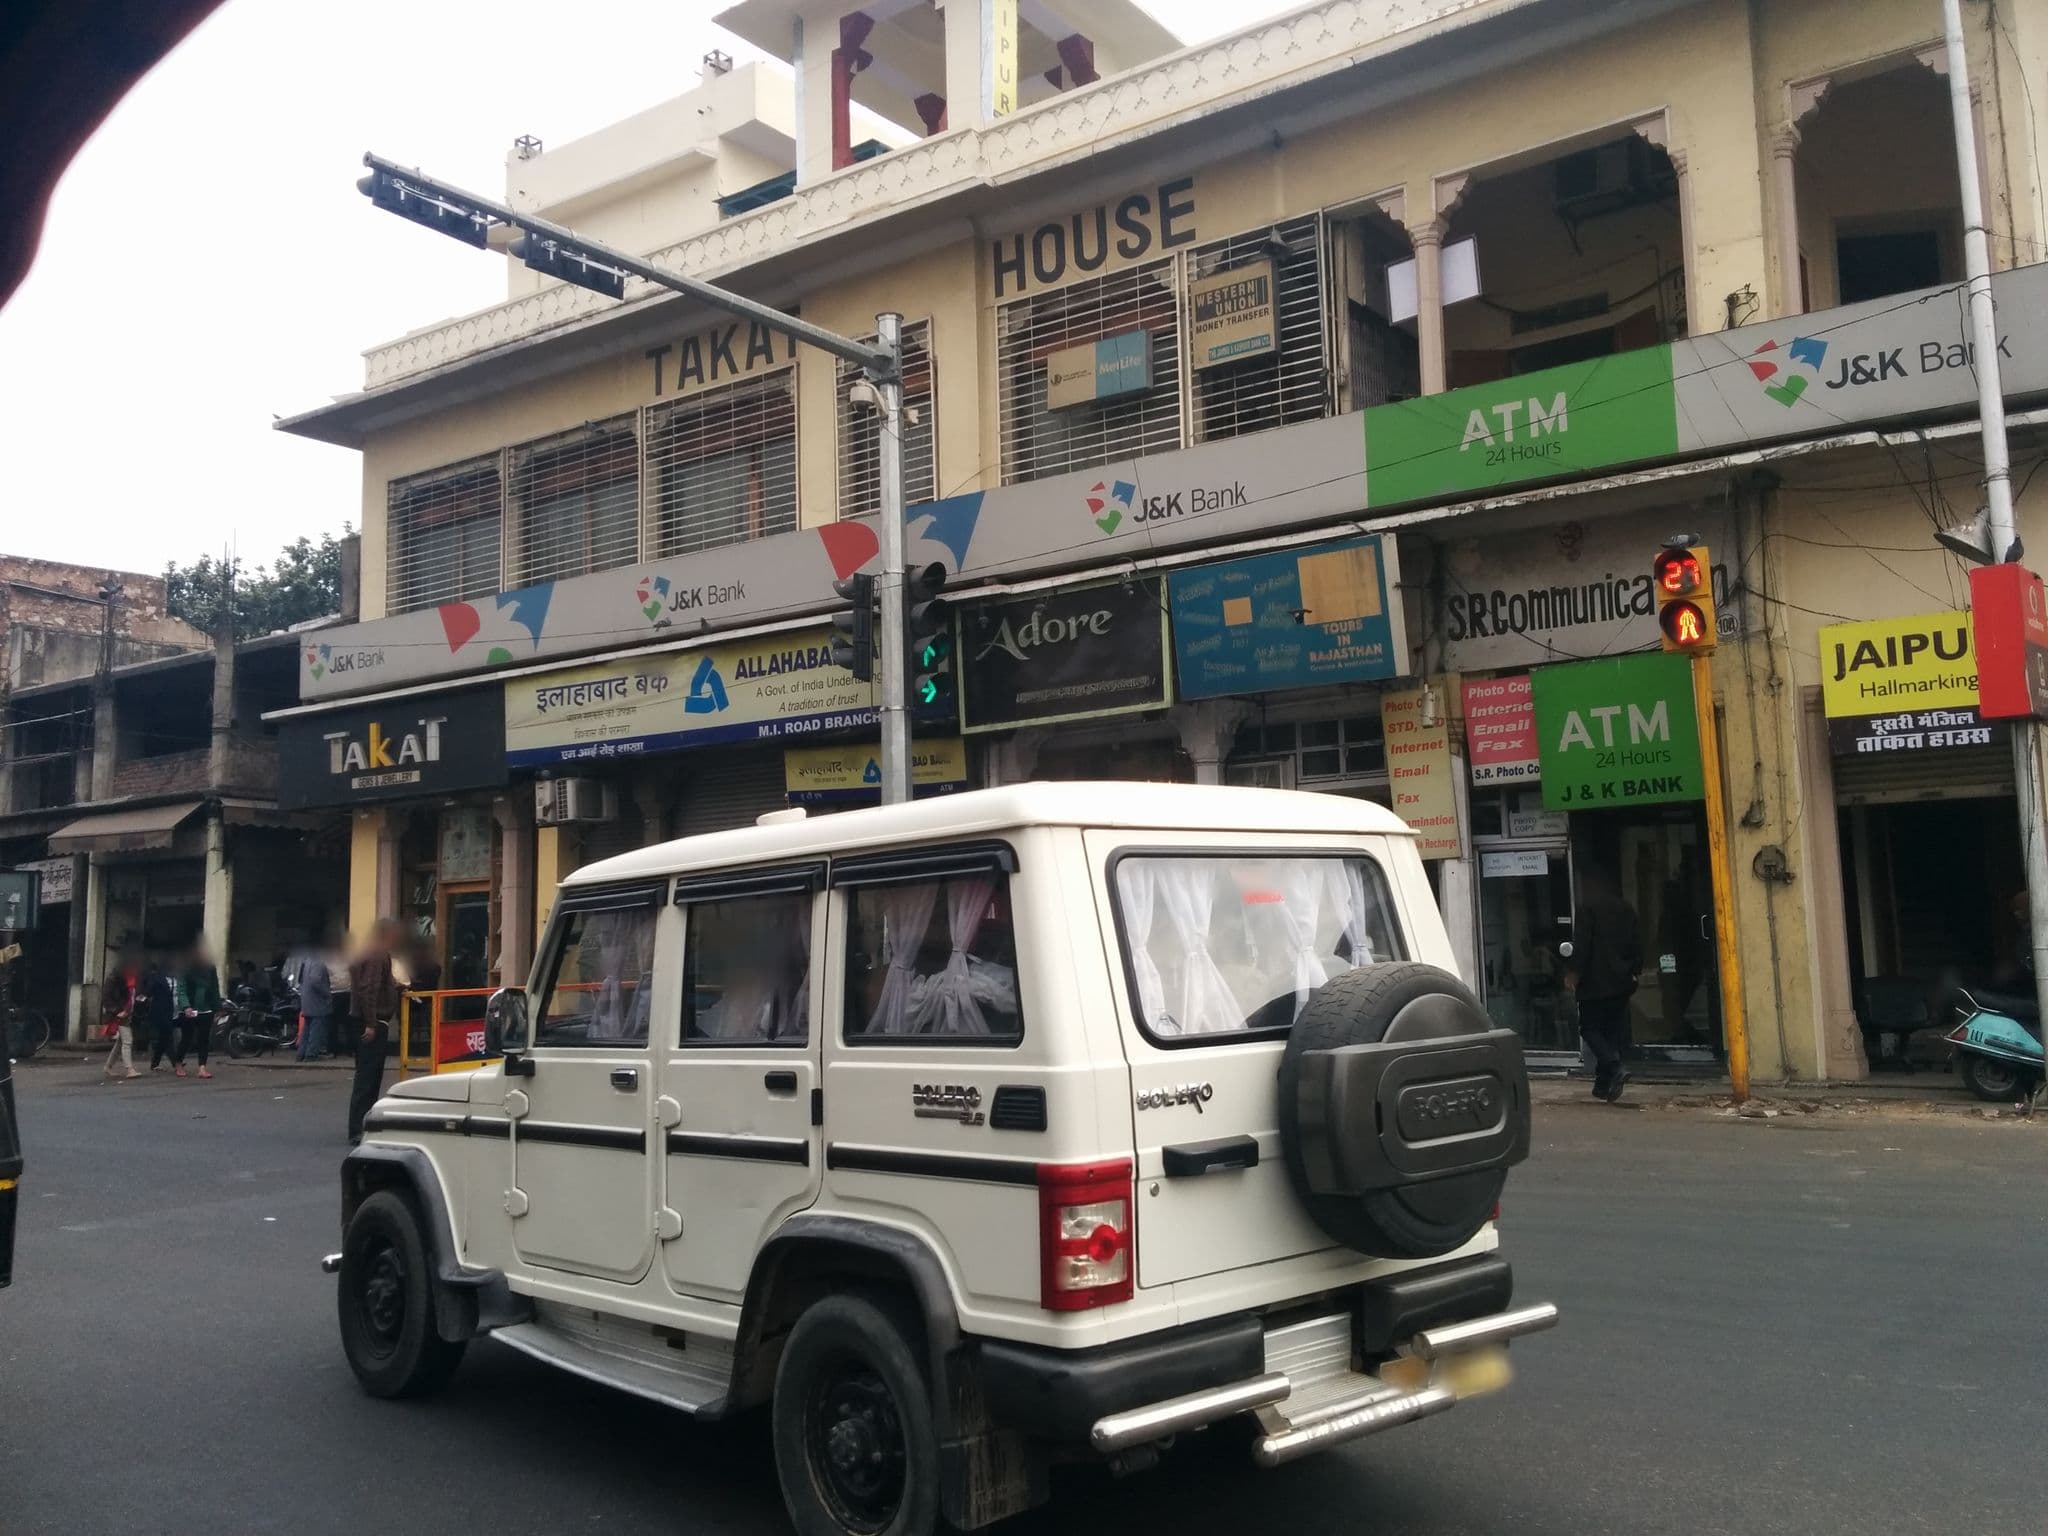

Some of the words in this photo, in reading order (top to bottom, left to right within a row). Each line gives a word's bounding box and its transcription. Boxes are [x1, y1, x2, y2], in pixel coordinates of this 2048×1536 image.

[994, 177, 1197, 299] HOUSE
[1196, 280, 1255, 306] WESTERN
[1216, 294, 1255, 316] UNION
[1196, 319, 1224, 334] MONEY
[1227, 307, 1270, 326] TRANSFER
[1825, 347, 1909, 390] J&K
[1459, 391, 1569, 452] ATM
[1485, 448, 1507, 468] 24
[1510, 439, 1562, 464] Hours
[1133, 491, 1185, 524] J&K
[1191, 481, 1247, 513] Bank
[1665, 560, 1700, 588] 27
[668, 587, 705, 612] J&K
[708, 580, 746, 606] Bank
[976, 609, 1112, 661] Adore
[329, 655, 355, 674] J&K
[357, 649, 386, 670] Bank
[735, 645, 833, 681] ALLAHABA
[1310, 644, 1382, 662] RAJASTHAN
[1833, 627, 1968, 682] JAIPU
[536, 675, 629, 712] इलाहाबाद
[756, 686, 763, 698] A
[765, 685, 789, 697] Govt.
[790, 681, 801, 693] of
[802, 679, 824, 692] India
[1468, 685, 1504, 699] Photo
[1508, 682, 1532, 694] Cop
[1860, 673, 1979, 698] Hallmarking
[779, 701, 788, 713] A
[789, 697, 825, 712] tradition
[826, 694, 837, 707] of
[838, 693, 859, 706] trust
[1385, 700, 1413, 713] Photo
[1471, 702, 1533, 718] Interne
[758, 723, 781, 738] M.I.
[785, 719, 821, 733] ROAD
[824, 712, 881, 730] BRANCH
[1388, 721, 1418, 734] STD,
[1474, 719, 1530, 736] Email
[1558, 700, 1671, 752] ATM
[1871, 713, 1914, 735] दूसरी
[1917, 711, 1974, 730] मंजिल
[1391, 740, 1444, 755] Internet
[1477, 739, 1525, 753] Fax
[1856, 731, 1924, 752] ताकत
[1928, 727, 1992, 748] हाउस
[1393, 765, 1430, 778] Email
[1475, 768, 1494, 780] S.R.
[1497, 766, 1524, 778] Photo
[1527, 763, 1540, 774] Co
[1596, 752, 1616, 769] 24
[1620, 749, 1671, 766] Hours
[1397, 794, 1420, 805] Fax
[1561, 786, 1572, 802] J
[1580, 784, 1594, 799] &
[1601, 781, 1617, 797] K
[1624, 776, 1683, 796] BANK
[1406, 815, 1455, 828] amination
[1425, 838, 1457, 850] Recharge
[913, 1084, 981, 1109] BOLERO
[1136, 1081, 1214, 1114] BOLERO
[1414, 1086, 1490, 1124] BOLERO
